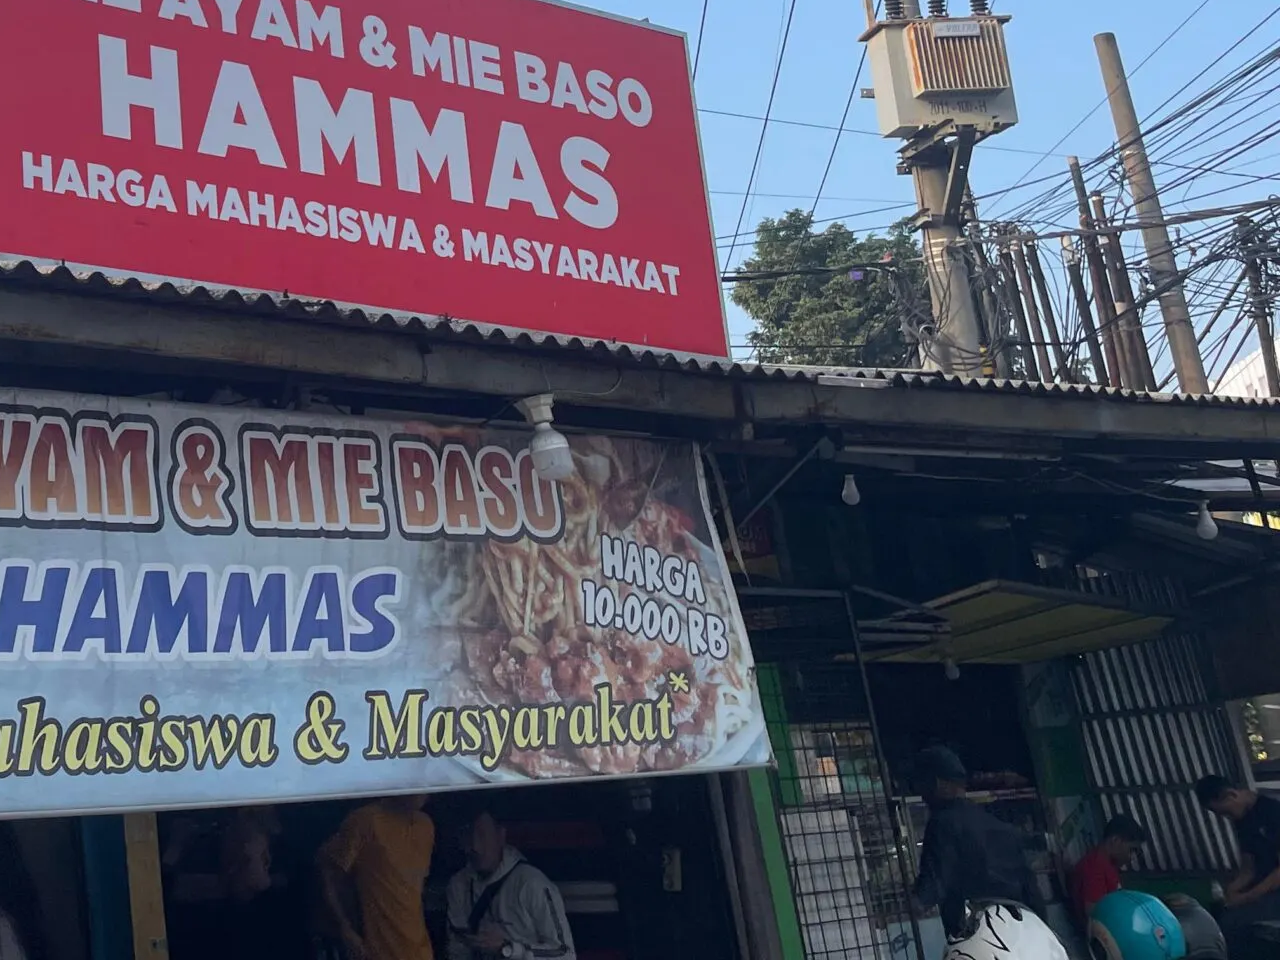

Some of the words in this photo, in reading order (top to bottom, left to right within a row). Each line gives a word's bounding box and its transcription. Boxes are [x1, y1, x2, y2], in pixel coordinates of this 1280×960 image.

[359, 15, 398, 70] &
[409, 25, 505, 95] MIE
[514, 51, 653, 127] BASO
[98, 33, 619, 229] HAMMAS
[22, 151, 178, 213] HARGA
[186, 179, 426, 254] MAHASISWA
[432, 223, 455, 258] &
[461, 228, 681, 296] MASYARAKAT
[175, 428, 230, 525] &
[245, 432, 384, 530] MIE
[395, 442, 562, 539] BASO
[582, 580, 680, 644] 10.000
[688, 609, 728, 659] RB
[601, 534, 705, 604] HARGA
[297, 694, 346, 760] &
[366, 683, 672, 770] Masyarakat
